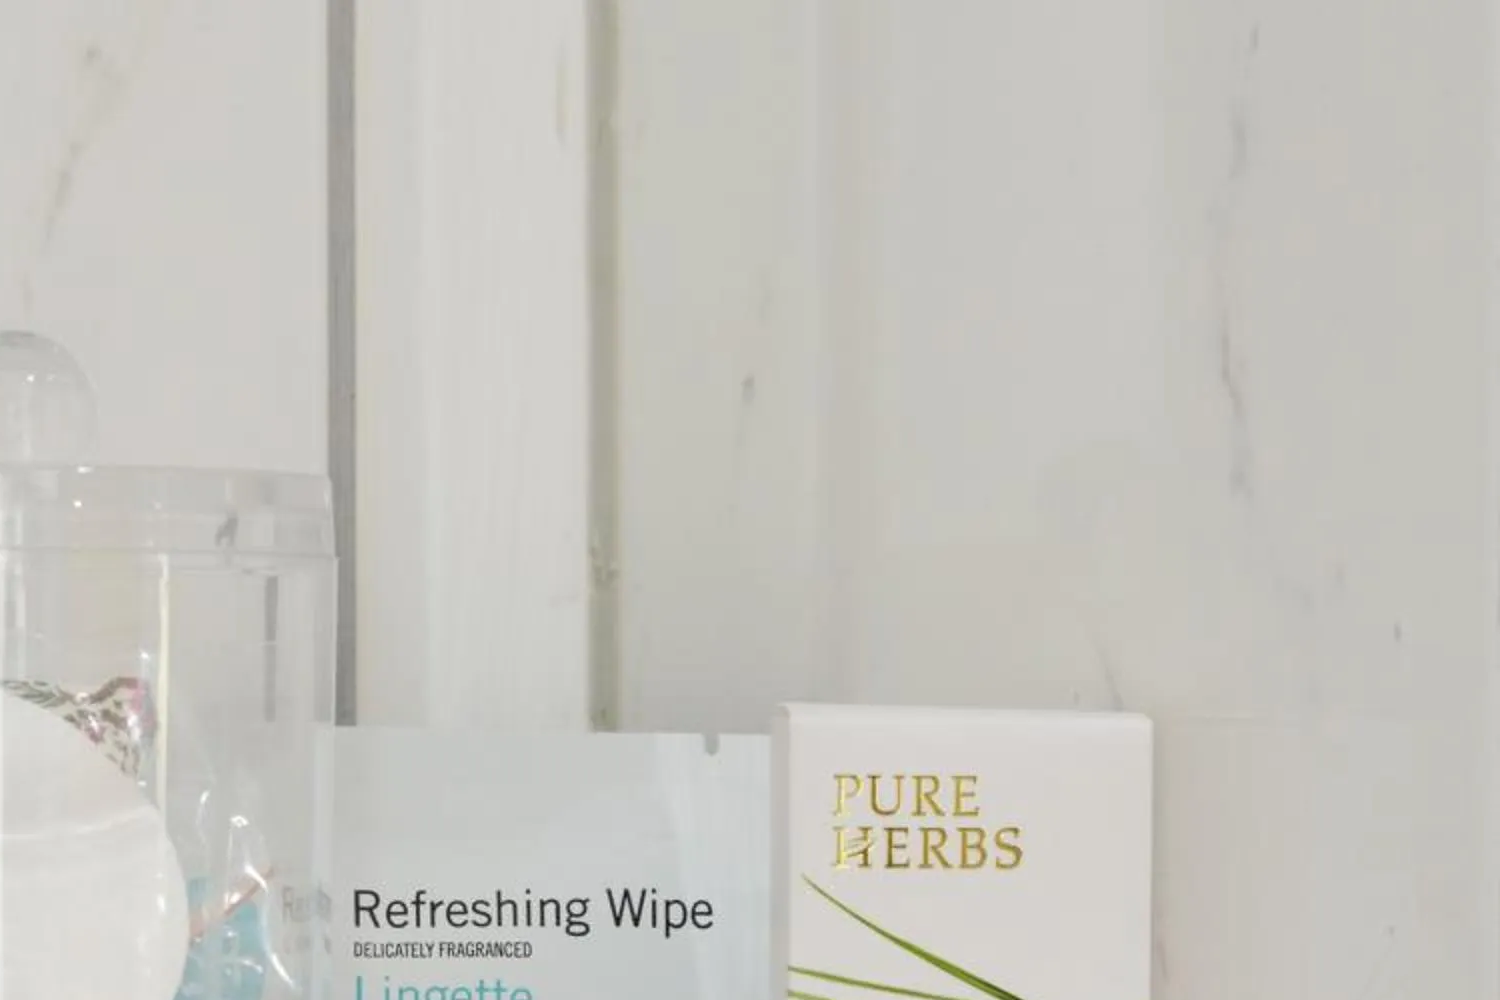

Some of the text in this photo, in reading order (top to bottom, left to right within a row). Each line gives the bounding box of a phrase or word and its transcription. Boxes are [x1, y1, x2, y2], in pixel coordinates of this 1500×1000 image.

[833, 774, 979, 817] PURE
[833, 826, 1023, 870] HERBS
[353, 888, 591, 938] Refreshing
[605, 888, 713, 939] Wipe
[353, 941, 434, 959] DELICATELY
[438, 941, 533, 959] FRAGRANCED
